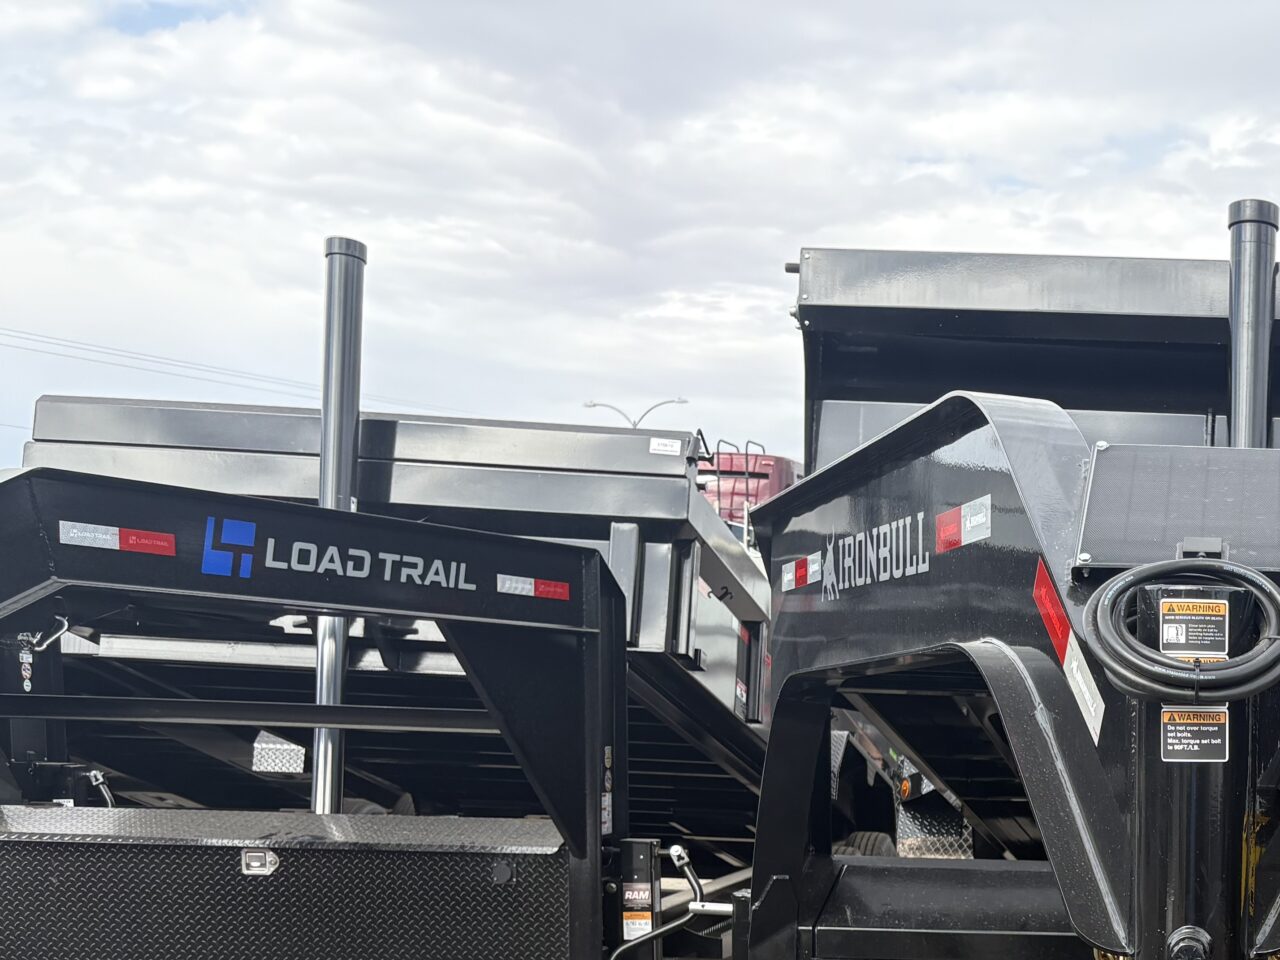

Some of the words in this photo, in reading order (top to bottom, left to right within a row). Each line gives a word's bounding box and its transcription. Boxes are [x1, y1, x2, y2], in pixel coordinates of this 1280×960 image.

[838, 511, 930, 590] IRONBULL
[265, 537, 372, 579] LOAD
[378, 552, 477, 591] TRAIL
[1176, 604, 1221, 613] WARNING
[1177, 713, 1221, 722] WARNING
[624, 890, 650, 900] RAM
